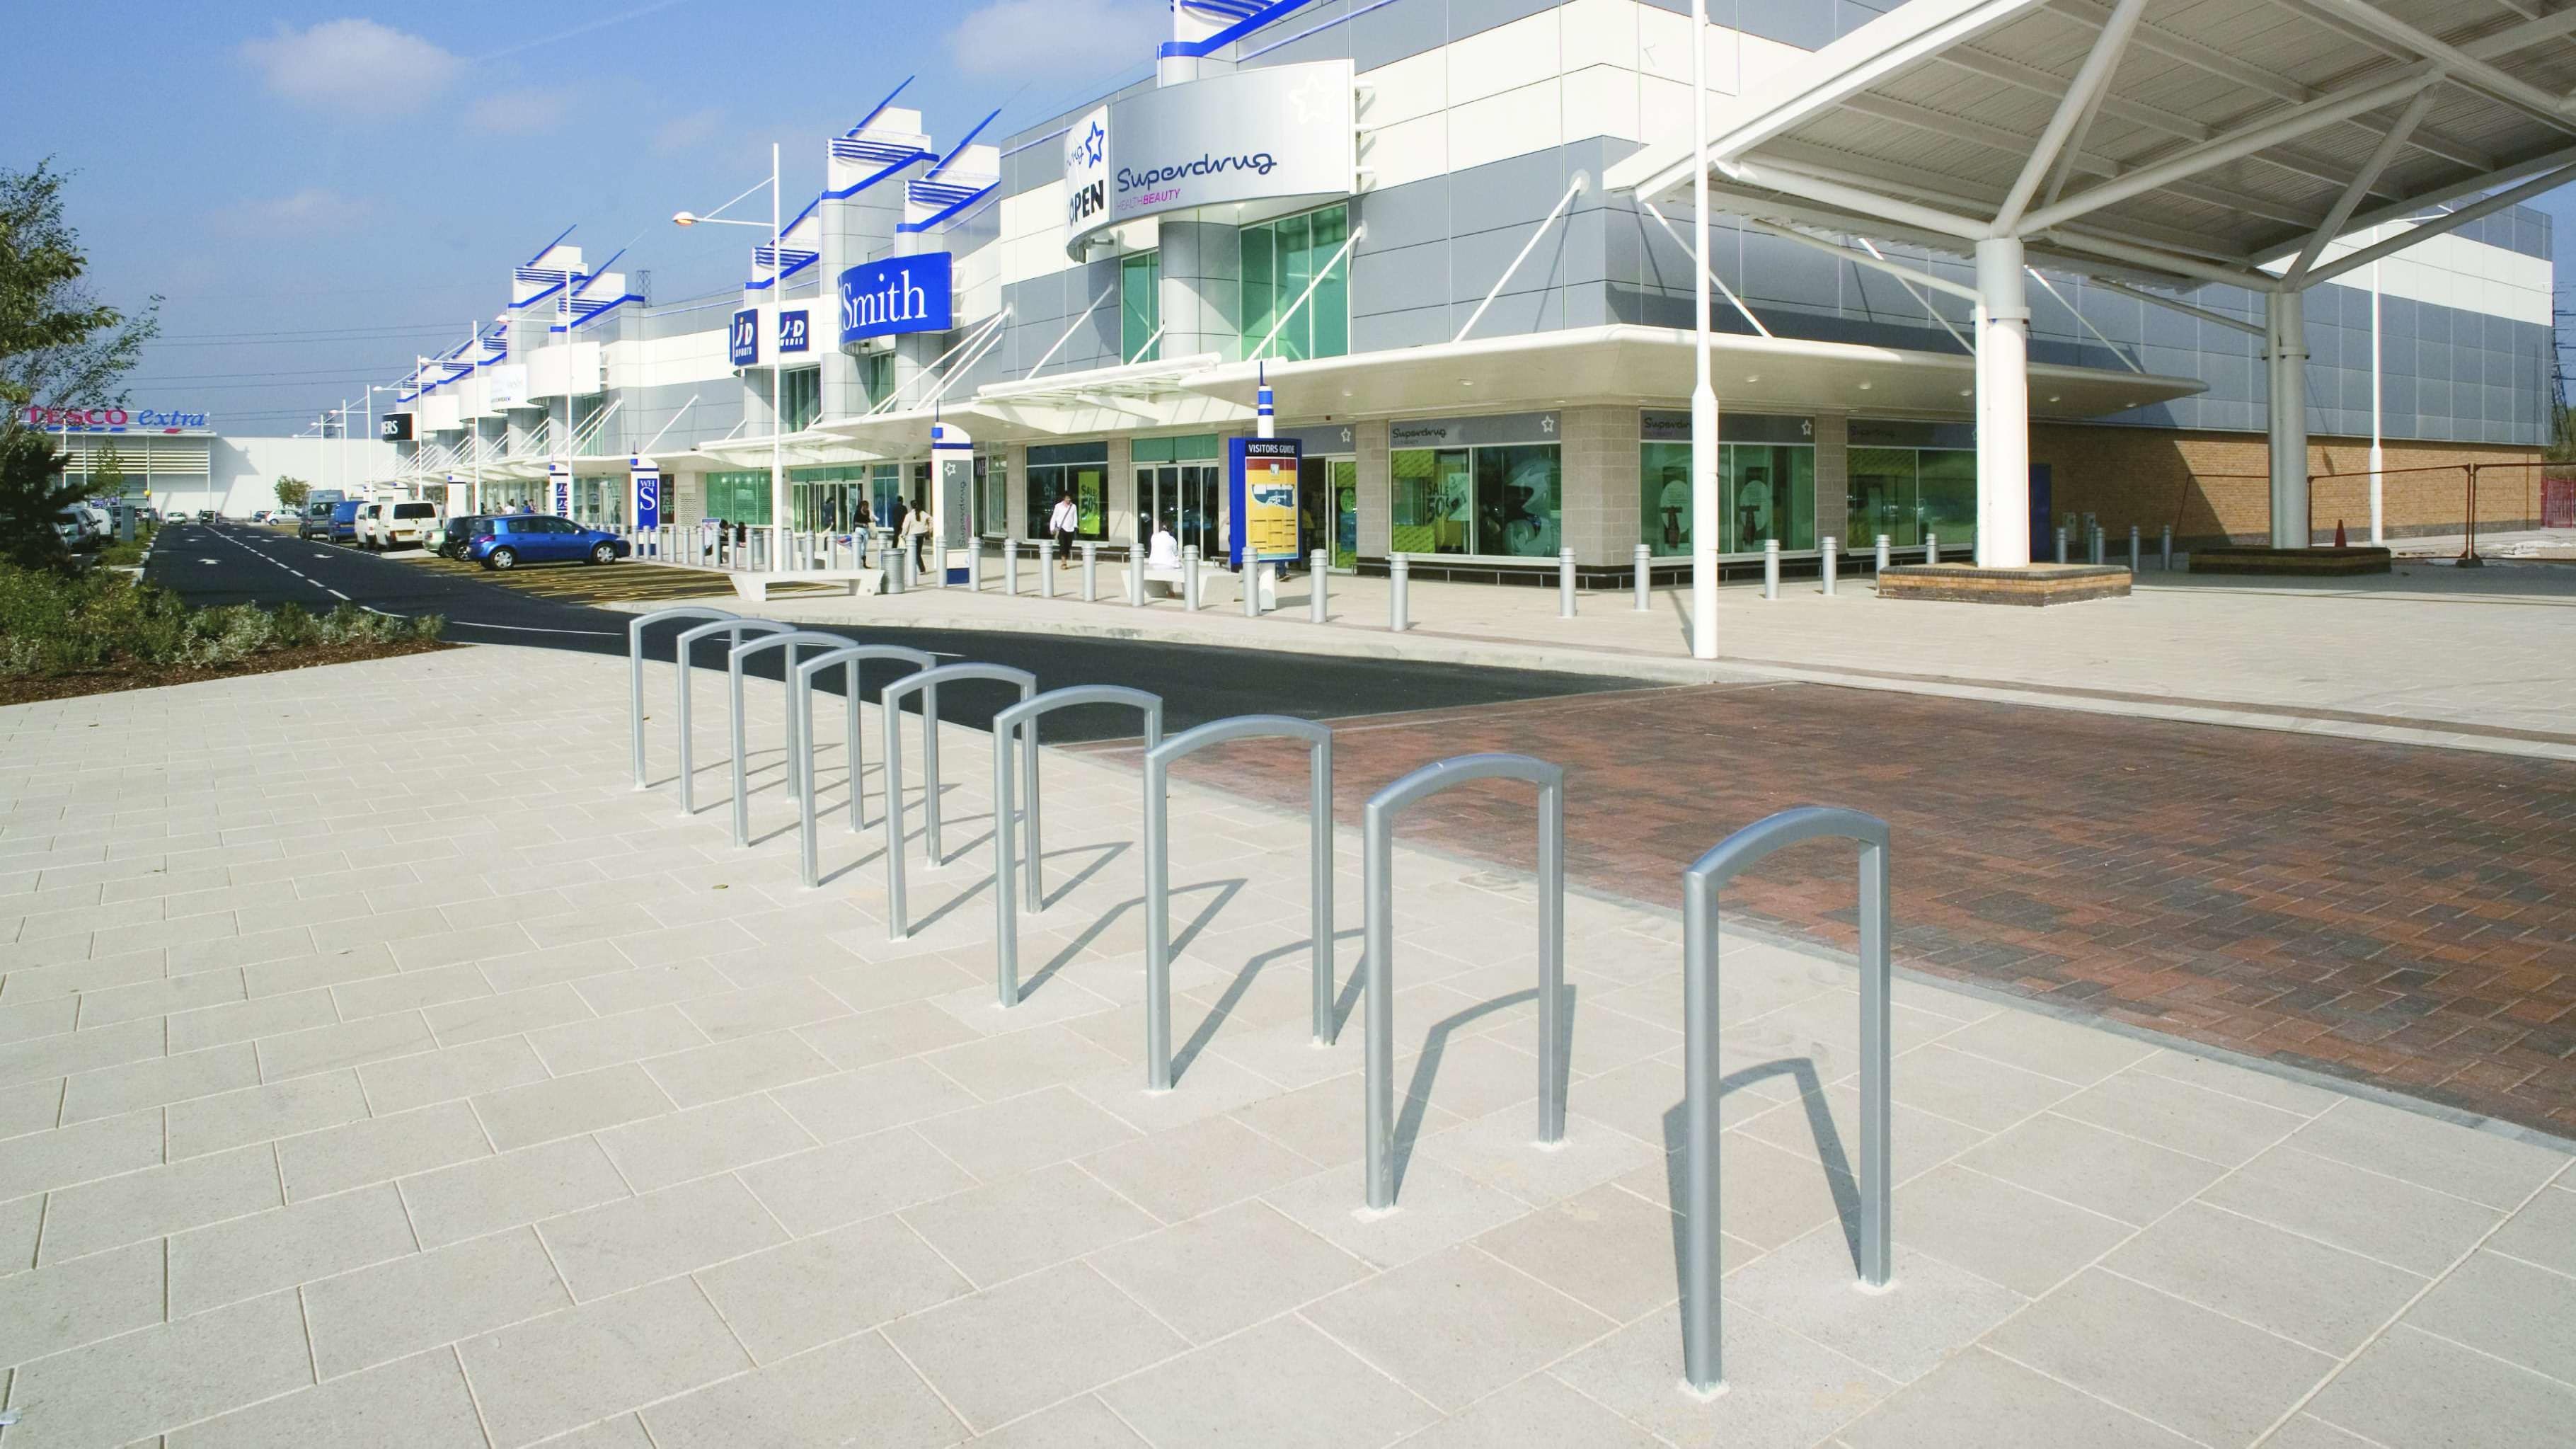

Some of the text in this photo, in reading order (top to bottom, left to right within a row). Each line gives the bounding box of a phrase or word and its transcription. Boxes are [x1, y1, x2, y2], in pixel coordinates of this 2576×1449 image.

[1117, 153, 1277, 192] Superdrug
[1069, 179, 1104, 227] OPEN
[25, 406, 129, 425] TESCO
[1392, 428, 1447, 439] Superdrug
[1248, 444, 1295, 453] VISITORS GUIDE
[640, 486, 656, 510] S
